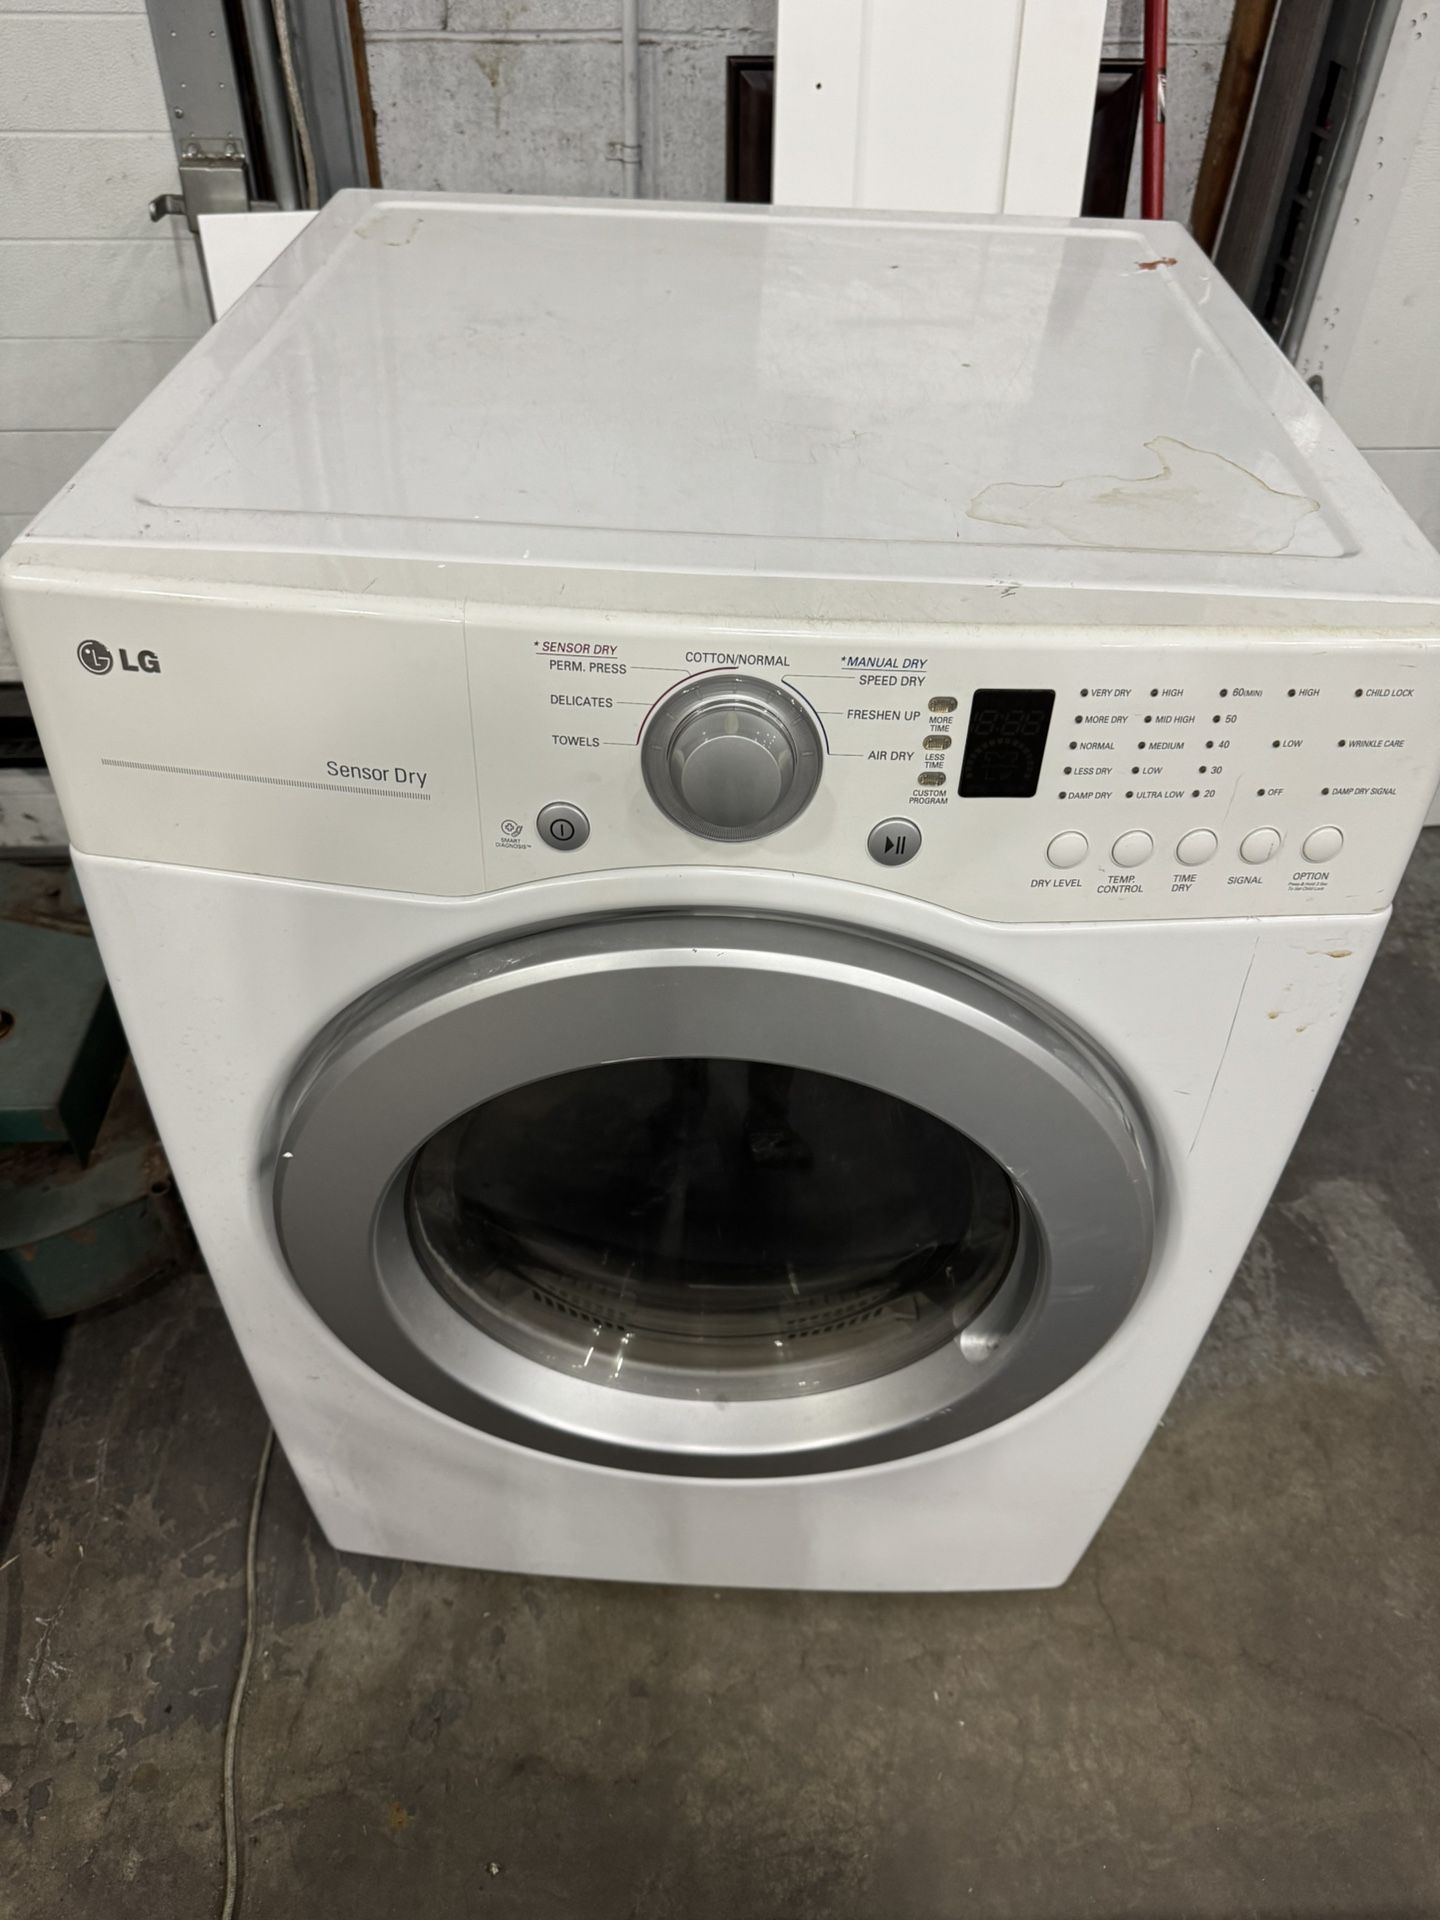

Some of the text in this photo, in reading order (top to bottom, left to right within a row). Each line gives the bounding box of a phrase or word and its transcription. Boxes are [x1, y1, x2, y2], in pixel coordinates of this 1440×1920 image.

[542, 641, 591, 655] SENSOR
[593, 643, 618, 655] DRY
[119, 648, 161, 673] LG
[685, 651, 790, 667] COTTON/NORMAL
[902, 657, 928, 670] DRY
[549, 659, 627, 674] PERM. PRESS
[859, 674, 926, 687] SPEED DRY
[1090, 688, 1132, 697] VERY DRY
[1161, 688, 1184, 697] HIGH
[1298, 688, 1321, 697] HIGH
[1365, 688, 1414, 697] CHILD LOCK
[549, 694, 613, 708] DELICATES
[846, 709, 921, 721] FRESHEN UP
[928, 716, 953, 724] MORE
[1084, 715, 1128, 724] MORE DRY
[1155, 715, 1196, 724] MID HIGH
[1224, 714, 1237, 724] 50
[930, 724, 950, 732] TIME
[552, 735, 600, 748] TOWELS
[1079, 741, 1115, 751] NORMAL
[1148, 741, 1185, 751] MEDIUM
[1217, 740, 1230, 749] 40
[1282, 739, 1303, 749] LOW
[1348, 739, 1405, 749] WRINKLE CARE
[867, 751, 915, 761] AIR DRY
[925, 753, 945, 761] LESS
[924, 761, 944, 769] TIME
[1210, 765, 1223, 775] 30
[326, 760, 428, 788] Sensor Dry
[1073, 767, 1113, 776] LESS DRY
[1142, 766, 1163, 775] LOW
[913, 789, 947, 797] CUSTOM
[1067, 791, 1113, 800] DAMP DRY
[1136, 790, 1185, 799] ULTRA LOW
[1203, 789, 1216, 799] 20
[1267, 788, 1285, 797] OFF
[1332, 787, 1397, 796] DAMP DRY SIGNAL
[909, 797, 948, 805] PROGRAM
[1107, 875, 1136, 885] TEMP.
[1172, 874, 1197, 884] TIME
[1227, 875, 1263, 885] SIGNAL
[1292, 871, 1330, 881] OPTION
[1030, 878, 1083, 888] DRY LEVEL
[1171, 883, 1193, 893] DRY
[1096, 884, 1144, 894] CONTROL
